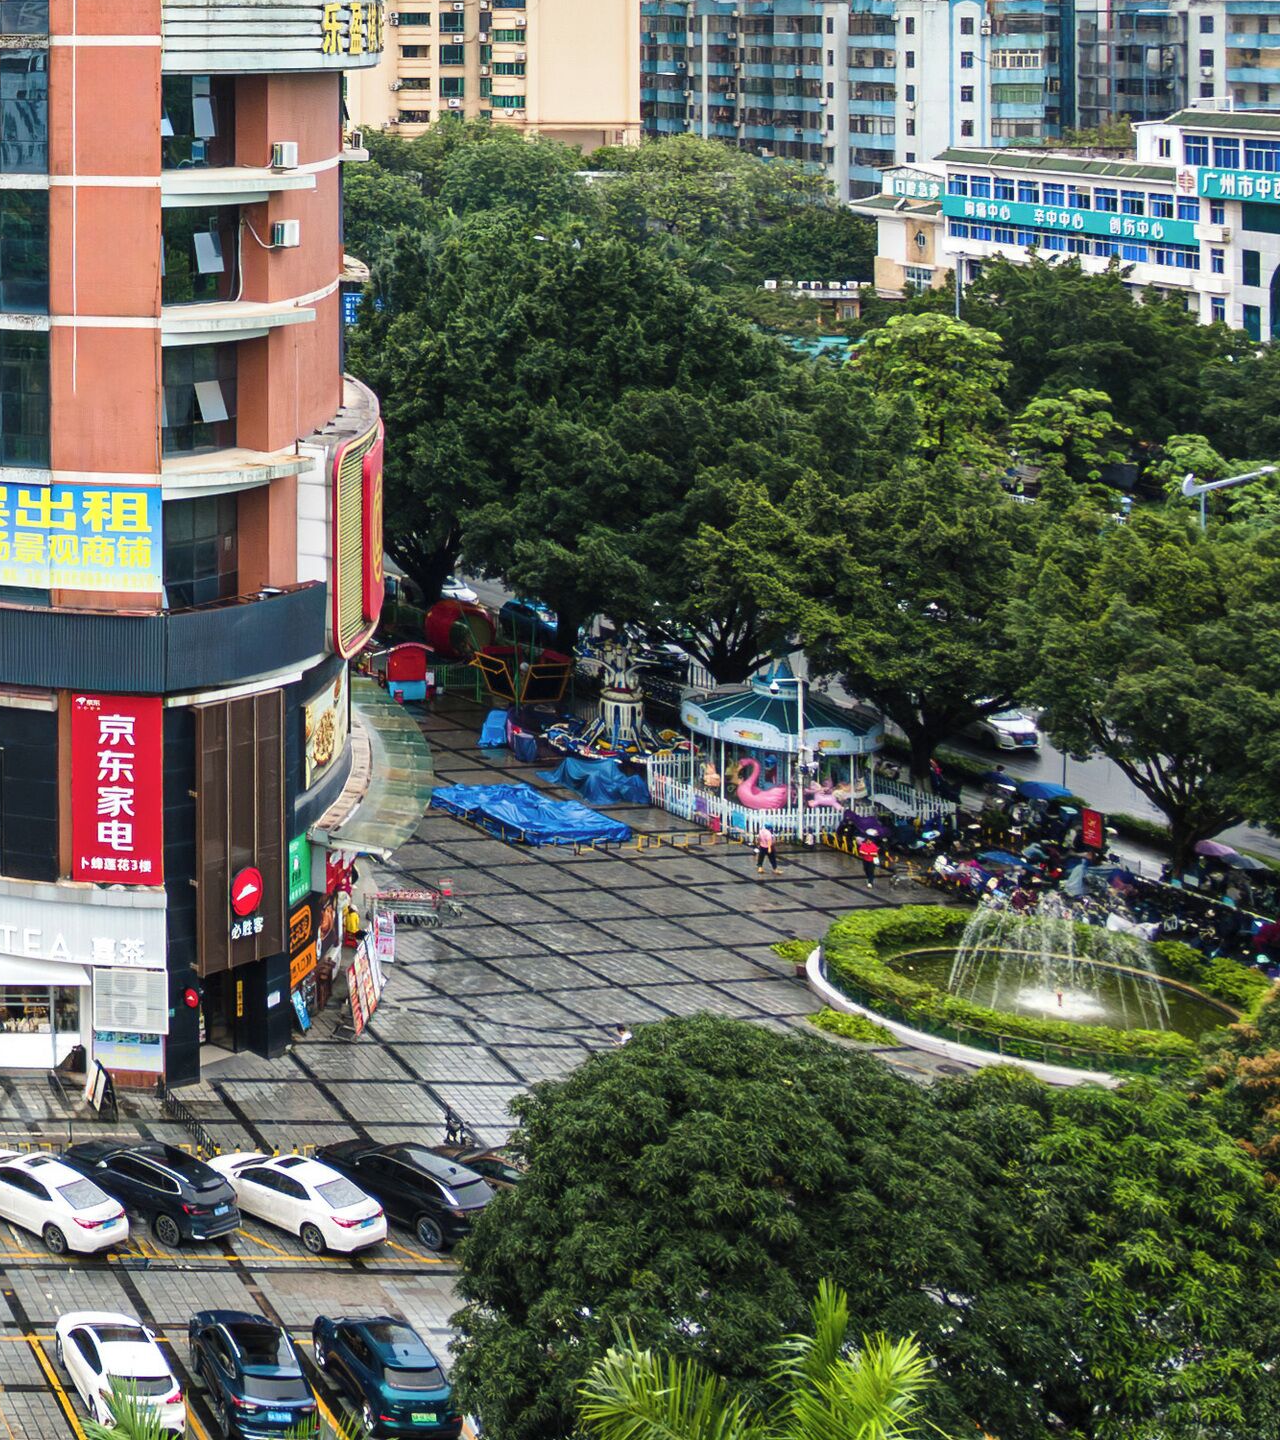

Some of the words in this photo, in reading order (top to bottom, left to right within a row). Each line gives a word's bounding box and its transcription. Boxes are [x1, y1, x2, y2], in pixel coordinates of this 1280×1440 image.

[97, 714, 136, 852] 京东家电
[81, 856, 152, 873] 卜蜂莲花3楼
[231, 916, 264, 940] 必胜客
[91, 937, 146, 964] 喜茶
